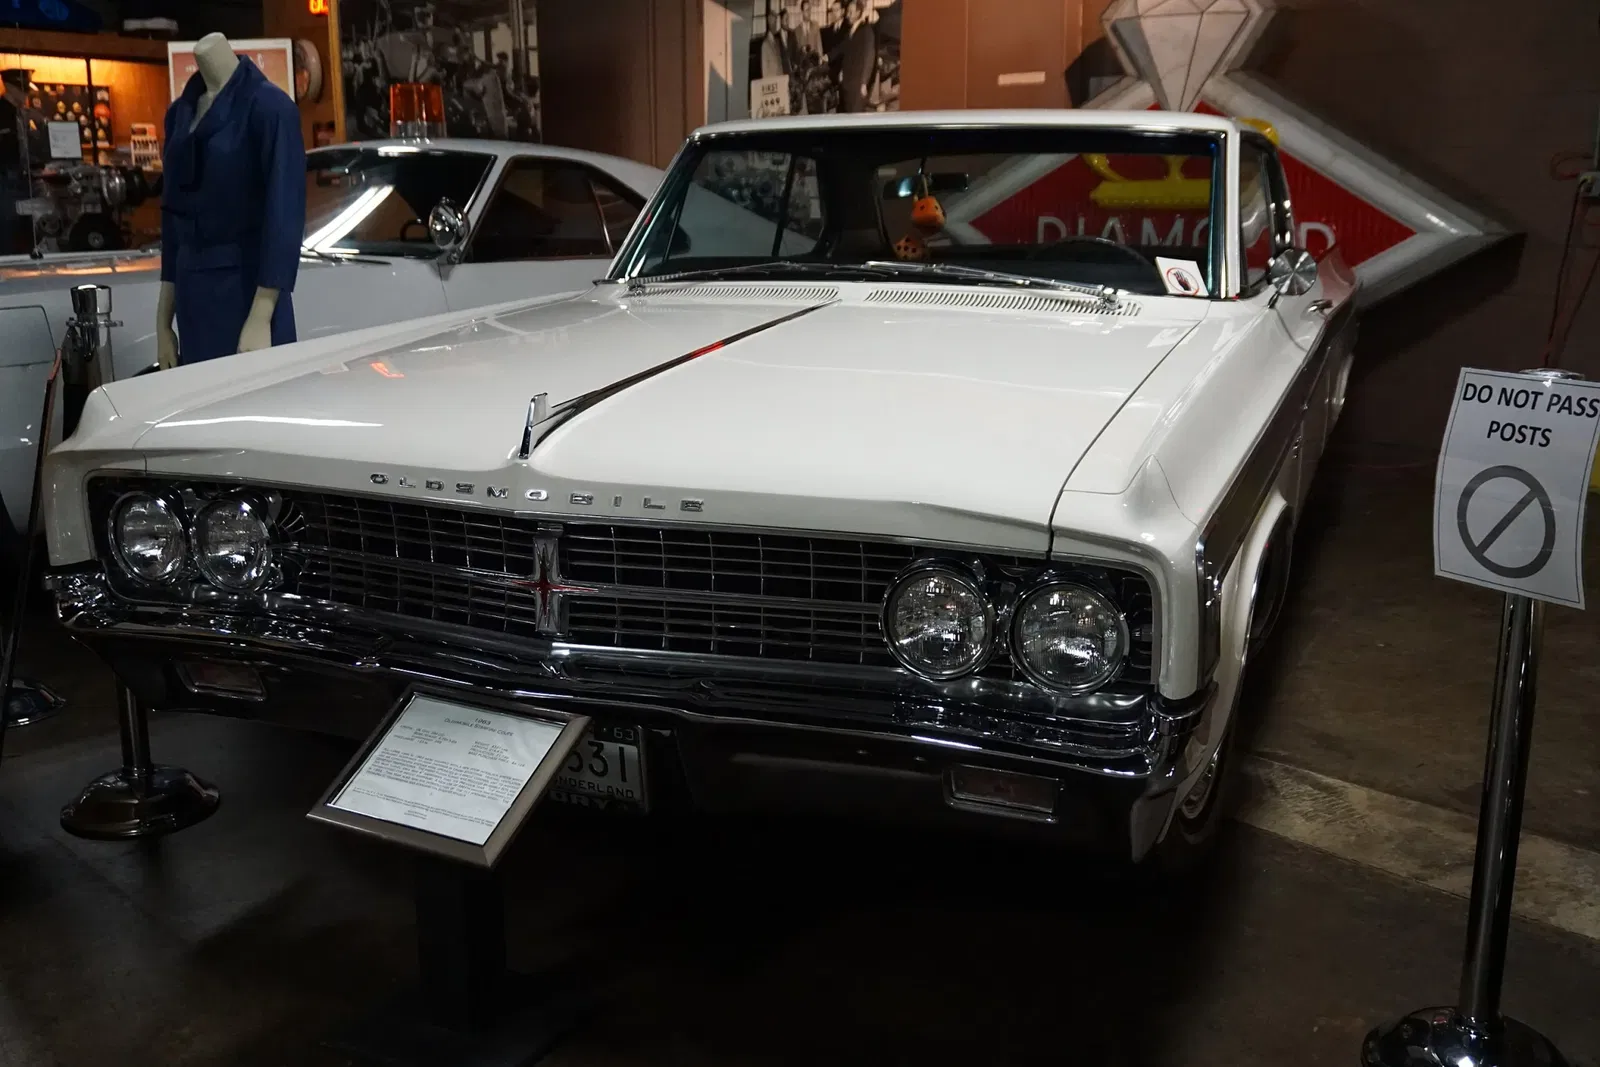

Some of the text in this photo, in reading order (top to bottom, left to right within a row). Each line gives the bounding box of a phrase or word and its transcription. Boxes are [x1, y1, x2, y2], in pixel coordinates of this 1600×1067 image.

[1462, 382, 1600, 419] DO NOT PASS
[1486, 420, 1553, 448] POSTS
[369, 472, 704, 512] OLDSMOBILE
[612, 727, 635, 742] 63
[556, 774, 635, 799] NDERLAND
